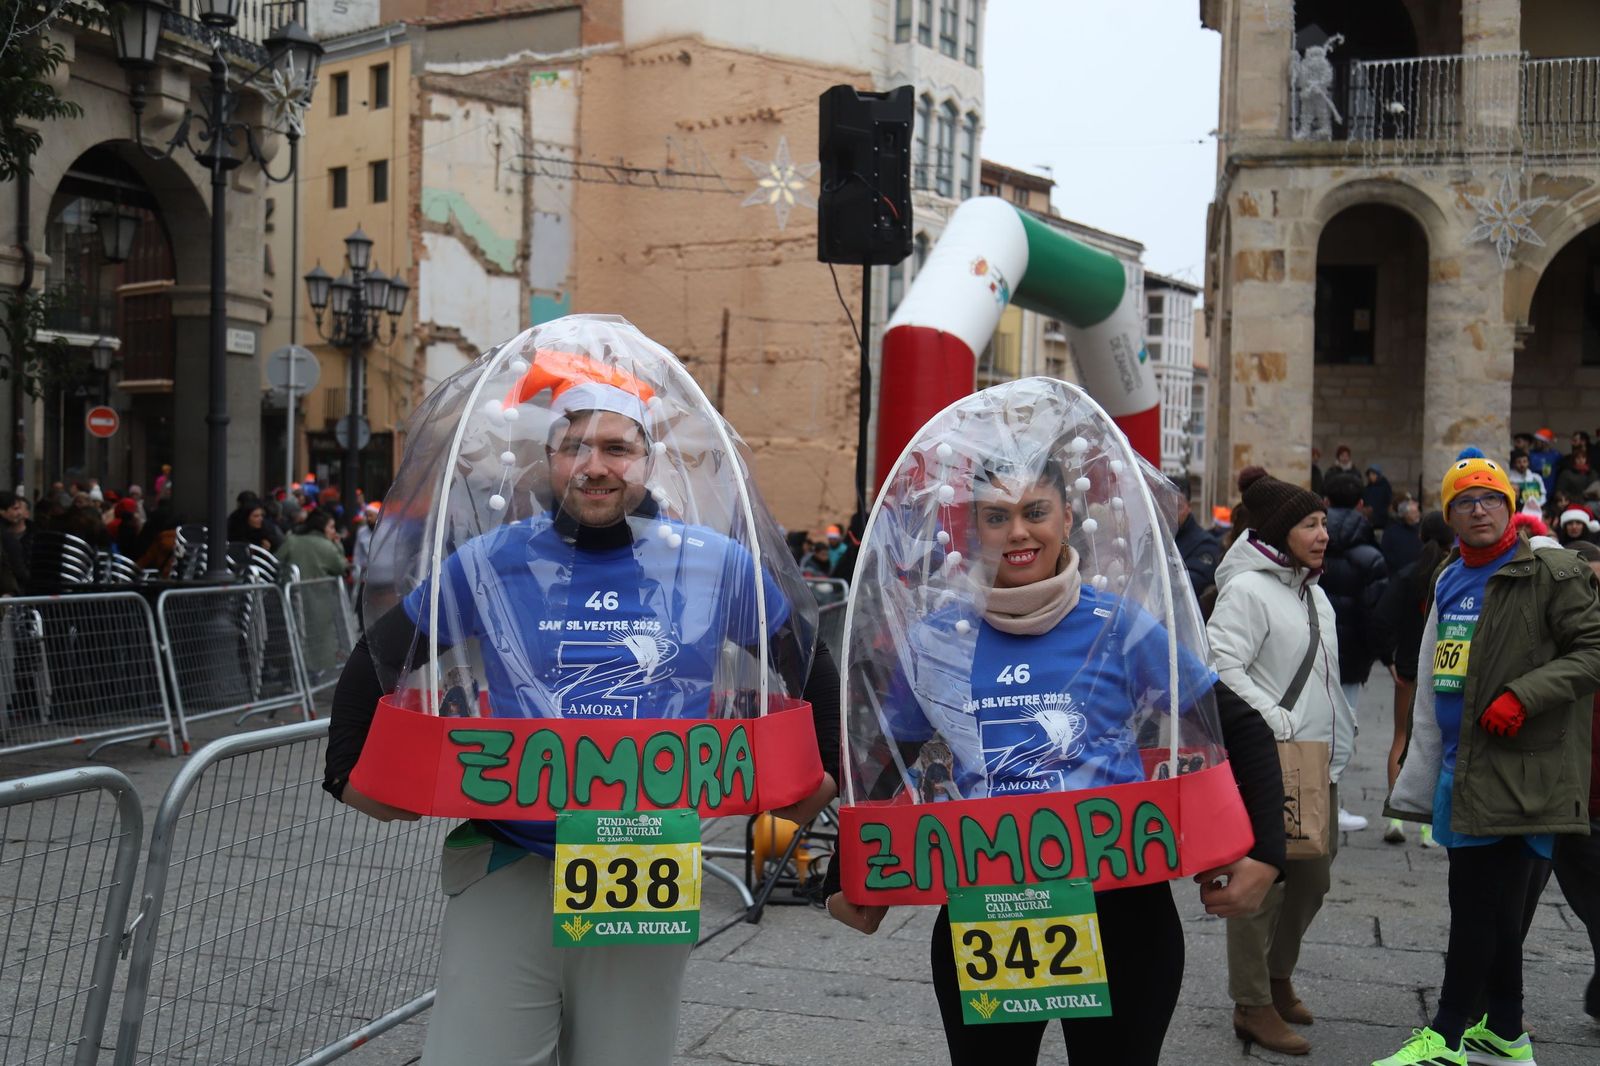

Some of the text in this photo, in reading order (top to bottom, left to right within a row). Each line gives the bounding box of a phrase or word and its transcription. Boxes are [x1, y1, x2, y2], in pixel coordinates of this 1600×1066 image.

[585, 591, 619, 611] 46
[1460, 596, 1475, 610] 46
[538, 620, 661, 631] SAN SILVESTRE 2025
[997, 663, 1031, 685] 46
[963, 693, 1072, 713] SAN SILVESTRE 2025
[448, 723, 755, 811] ZAMORA
[597, 827, 662, 836] CAJA RURAL
[860, 797, 1179, 890] ZAMORA
[564, 857, 680, 910] 938
[986, 899, 1052, 912] CAJA RURAL
[595, 921, 691, 935] CAJA RURAL
[962, 924, 1083, 981] 342
[1003, 994, 1102, 1013] CAJA RURAL
